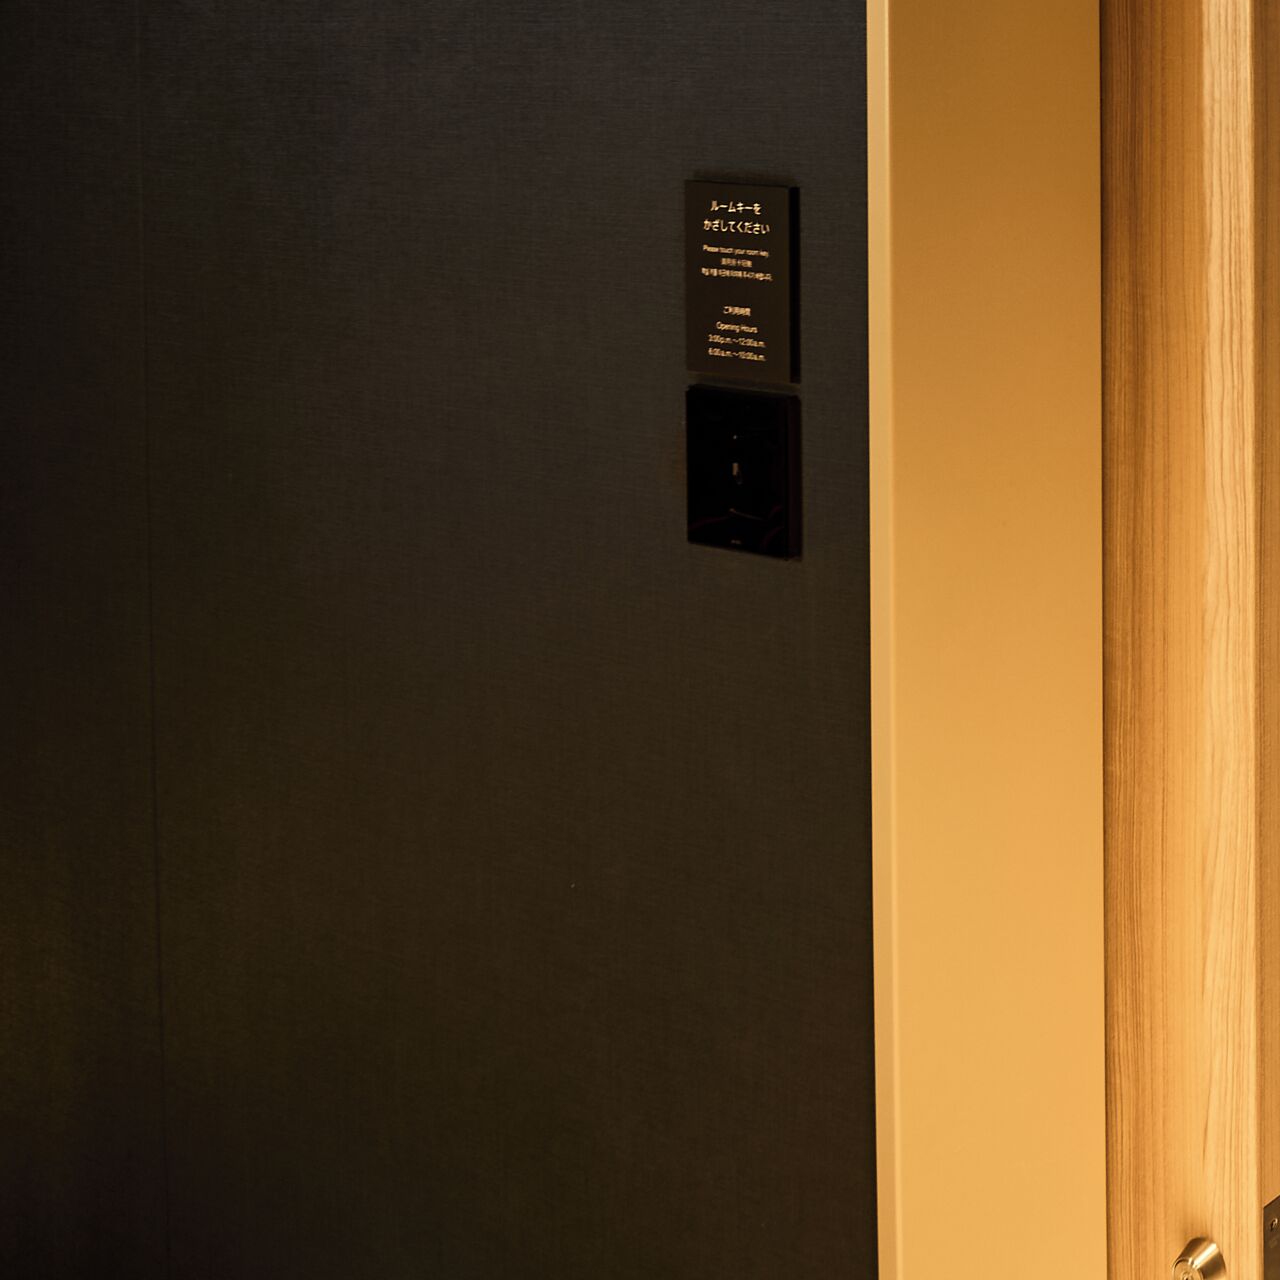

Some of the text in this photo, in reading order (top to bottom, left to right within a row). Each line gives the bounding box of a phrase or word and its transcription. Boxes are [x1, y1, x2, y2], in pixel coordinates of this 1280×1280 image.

[710, 200, 762, 215] ルームキーを
[703, 219, 770, 234] かざしてください
